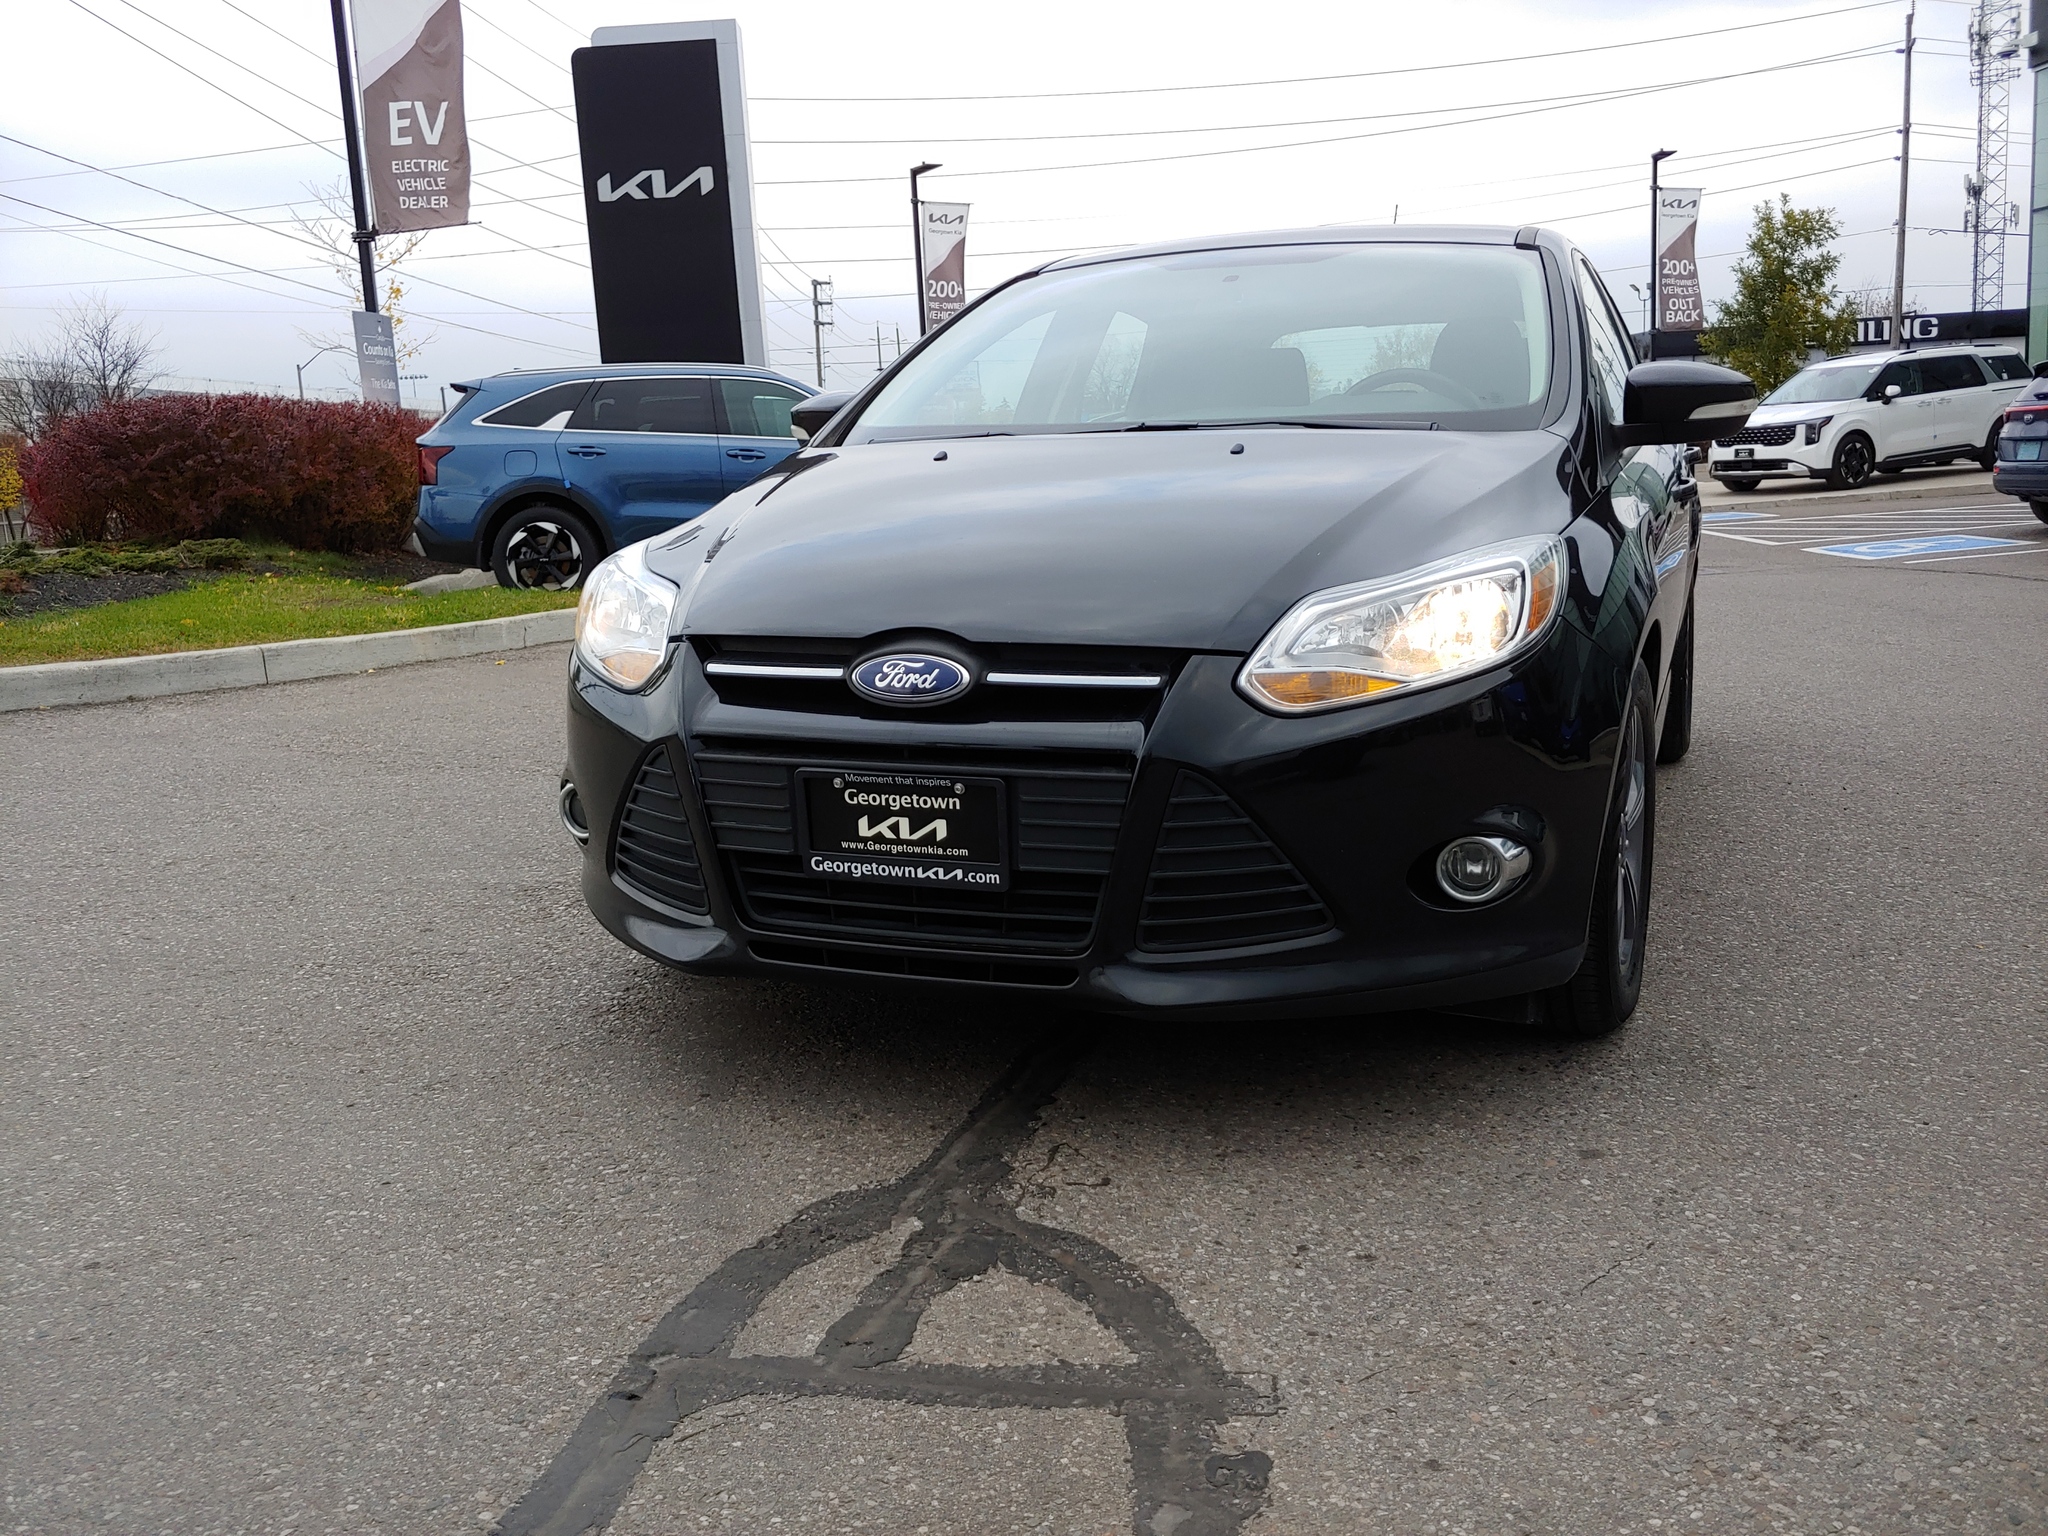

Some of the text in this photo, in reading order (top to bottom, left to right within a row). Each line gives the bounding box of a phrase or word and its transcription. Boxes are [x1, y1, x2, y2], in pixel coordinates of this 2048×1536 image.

[388, 101, 449, 146] EV
[391, 159, 450, 174] ELECTRIC
[396, 177, 447, 192] VEHICLE
[399, 195, 449, 209] DEALER
[1662, 258, 1695, 275] 200+
[928, 280, 963, 298] 200+
[1668, 297, 1695, 310] OUT
[1665, 309, 1701, 322] BACK
[874, 660, 940, 689] Ford
[844, 773, 951, 788] Movement that inspires
[844, 788, 961, 811] Georgetown
[841, 840, 969, 857] www.Georgetownkia.com
